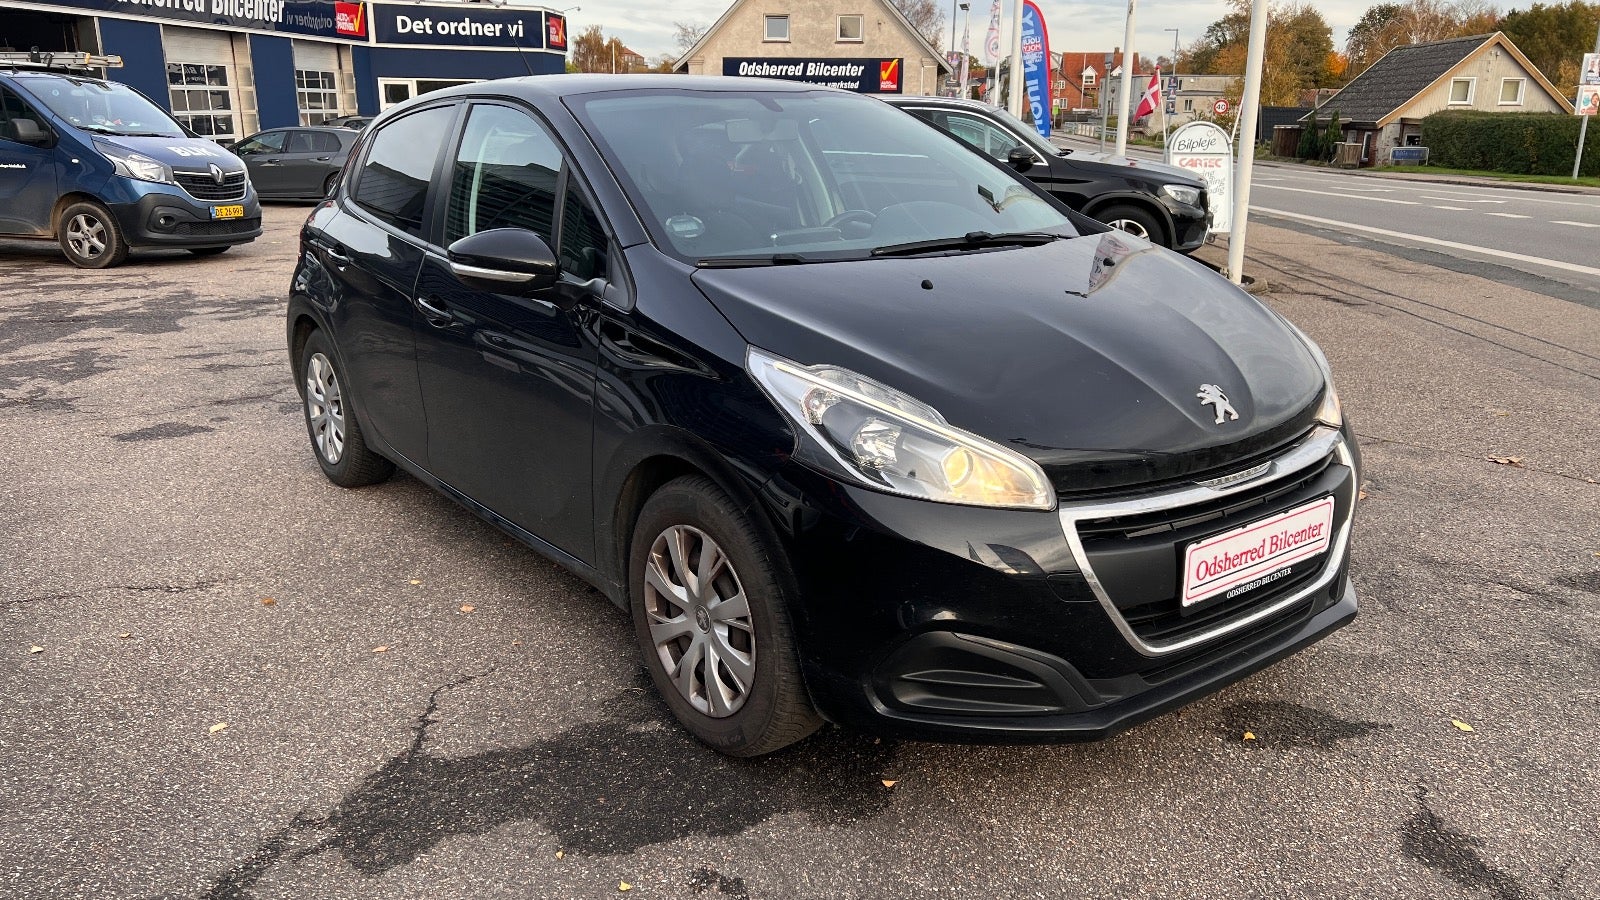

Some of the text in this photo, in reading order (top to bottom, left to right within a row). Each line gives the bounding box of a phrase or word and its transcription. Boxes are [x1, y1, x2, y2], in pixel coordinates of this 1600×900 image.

[396, 15, 524, 37] Det ordner vi
[739, 61, 865, 76] Odsherred Bilcenter
[1177, 137, 1217, 152] Bilpleje
[1178, 157, 1223, 168] CARTEC
[1196, 522, 1324, 581] Odsherred Bilcenter
[1226, 567, 1292, 599] ODSHERRED BILCENTER
